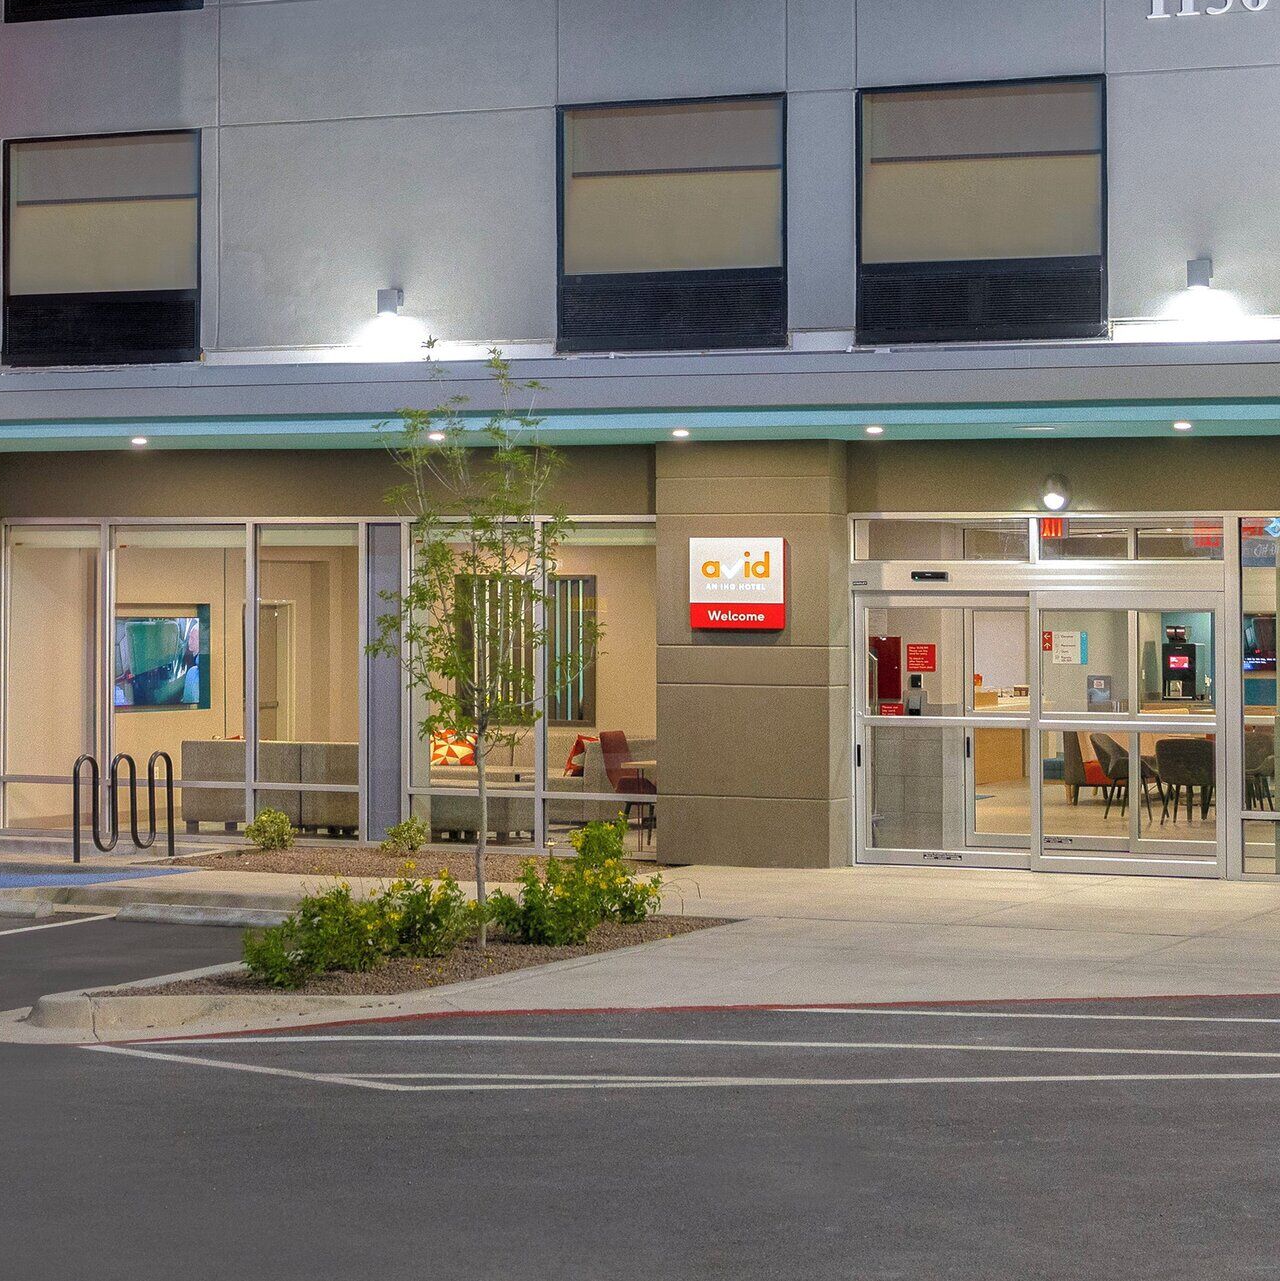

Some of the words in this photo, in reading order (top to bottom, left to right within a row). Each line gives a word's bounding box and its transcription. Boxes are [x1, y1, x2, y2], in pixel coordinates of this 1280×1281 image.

[701, 551, 770, 579] avid
[705, 583, 718, 591] AN
[738, 583, 766, 591] HOTEL
[708, 610, 765, 622] Welcome
